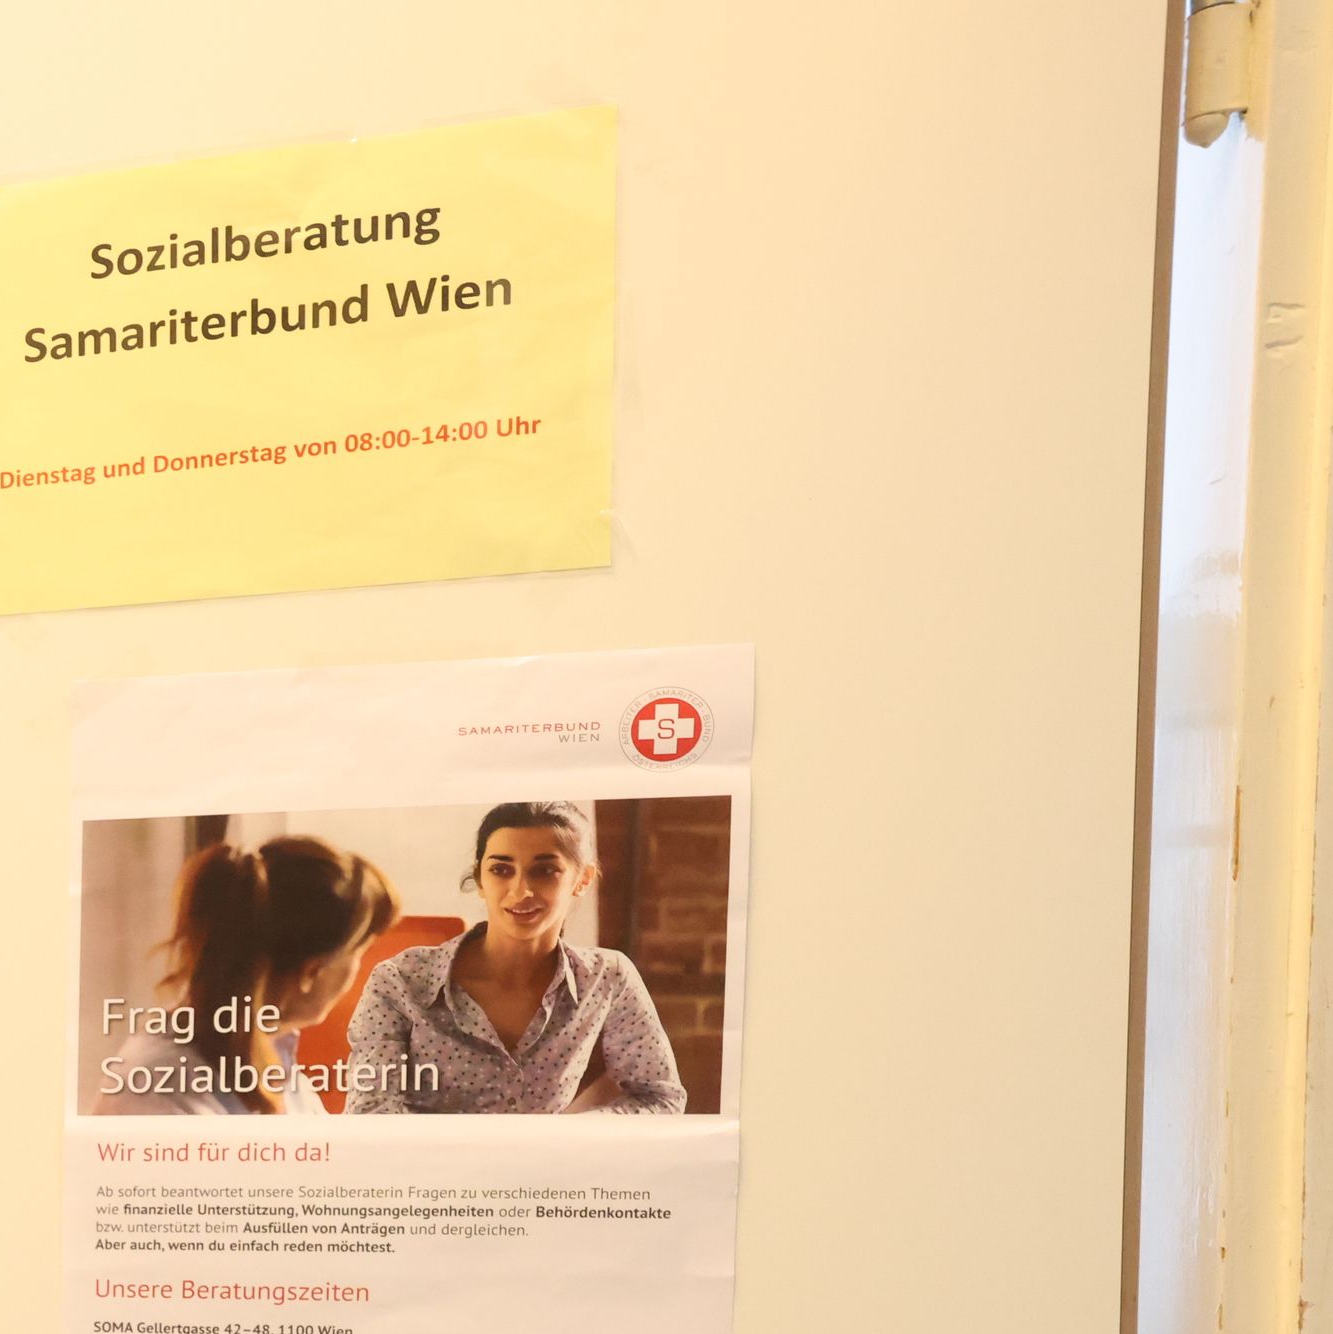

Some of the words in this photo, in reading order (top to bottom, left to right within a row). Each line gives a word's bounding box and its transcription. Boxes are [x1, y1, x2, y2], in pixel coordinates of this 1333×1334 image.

[91, 208, 440, 279] Sozialberatung
[25, 284, 368, 362] Samariterbund
[386, 275, 511, 317] Wien
[0, 467, 96, 489] Dienstag
[103, 456, 145, 478] und
[154, 446, 287, 473] Donnerstag
[294, 441, 337, 458] von
[345, 421, 488, 452] 08:00-14:00
[497, 416, 541, 437] Uhr
[459, 722, 600, 736] SAMARITERBUND
[558, 733, 599, 743] WIEN
[101, 997, 197, 1045] Frag
[212, 994, 282, 1035] die
[99, 1054, 441, 1095] Sozialberaterin
[98, 1143, 135, 1161] Wir
[143, 1143, 189, 1162] sind
[198, 1142, 229, 1162] für
[238, 1142, 285, 1162] dich
[295, 1142, 329, 1161] da!
[97, 1186, 113, 1197] Ab
[118, 1186, 156, 1197] sofort
[161, 1186, 243, 1198] beantwortet
[248, 1189, 293, 1198] unsere
[299, 1186, 403, 1198] Sozialberaterin
[409, 1186, 456, 1201] Fragen
[461, 1190, 476, 1199] zu
[482, 1187, 585, 1199] verschiedenen
[591, 1188, 650, 1200] Themen
[96, 1204, 119, 1215] wie
[124, 1204, 193, 1215] finanzielle
[198, 1204, 298, 1218] Unterstützung,
[302, 1205, 493, 1219] Wohnungsangelegenheiten
[499, 1206, 531, 1217] oder
[536, 1206, 671, 1219] Behördenkontakte
[96, 1221, 123, 1232] bzw.
[128, 1223, 200, 1233] unterstützt
[205, 1222, 238, 1233] beim
[243, 1222, 308, 1233] Ausfüllen
[312, 1225, 337, 1234] von
[341, 1223, 404, 1237] Anträgen
[410, 1224, 436, 1235] und
[442, 1224, 528, 1238] dergleichen.
[95, 1239, 126, 1250] Aber
[130, 1240, 164, 1252] auch,
[209, 1240, 225, 1251] du
[230, 1240, 278, 1251] einfach
[284, 1241, 322, 1252] reden
[328, 1241, 395, 1252] möchtest.
[96, 1279, 172, 1298] Unsere
[182, 1280, 369, 1305] Beratungszeiten
[94, 1321, 133, 1332] SOMA
